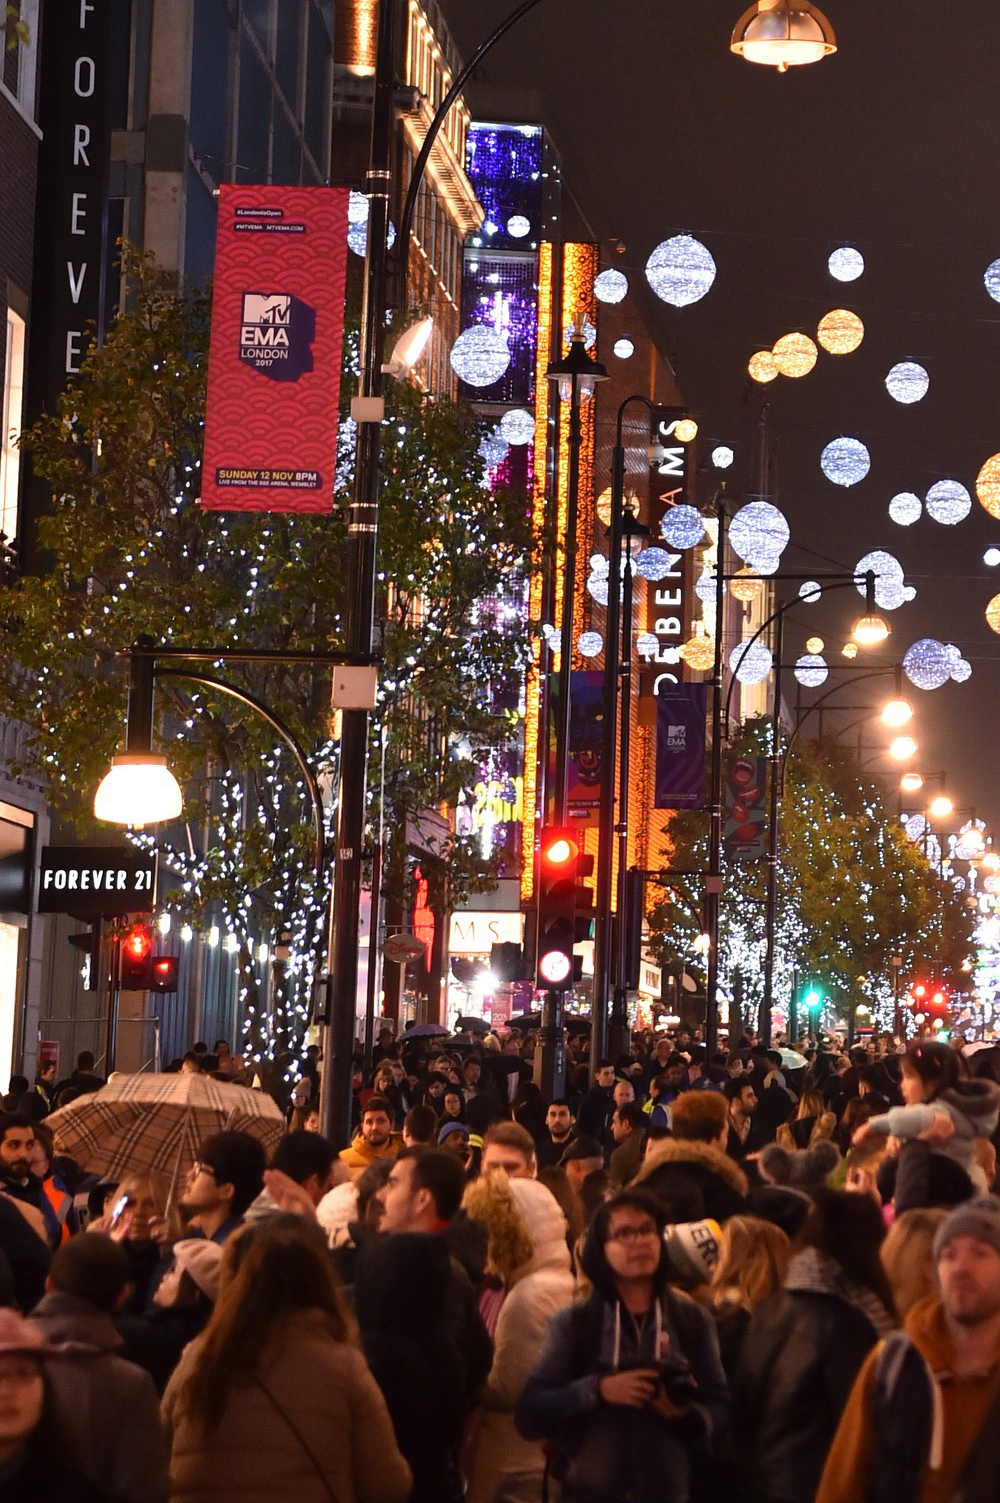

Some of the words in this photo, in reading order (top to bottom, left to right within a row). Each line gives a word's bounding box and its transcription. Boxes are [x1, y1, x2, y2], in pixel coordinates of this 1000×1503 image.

[243, 294, 291, 324] MTV
[240, 326, 289, 346] EMA
[241, 348, 288, 359] LONDON
[219, 469, 258, 479] SUNDAY
[260, 471, 270, 480] 12
[272, 472, 293, 481] NOV
[295, 472, 317, 482] 8PM
[667, 738, 686, 746] EMA
[44, 869, 127, 890] FOREVER
[134, 870, 152, 890] 21
